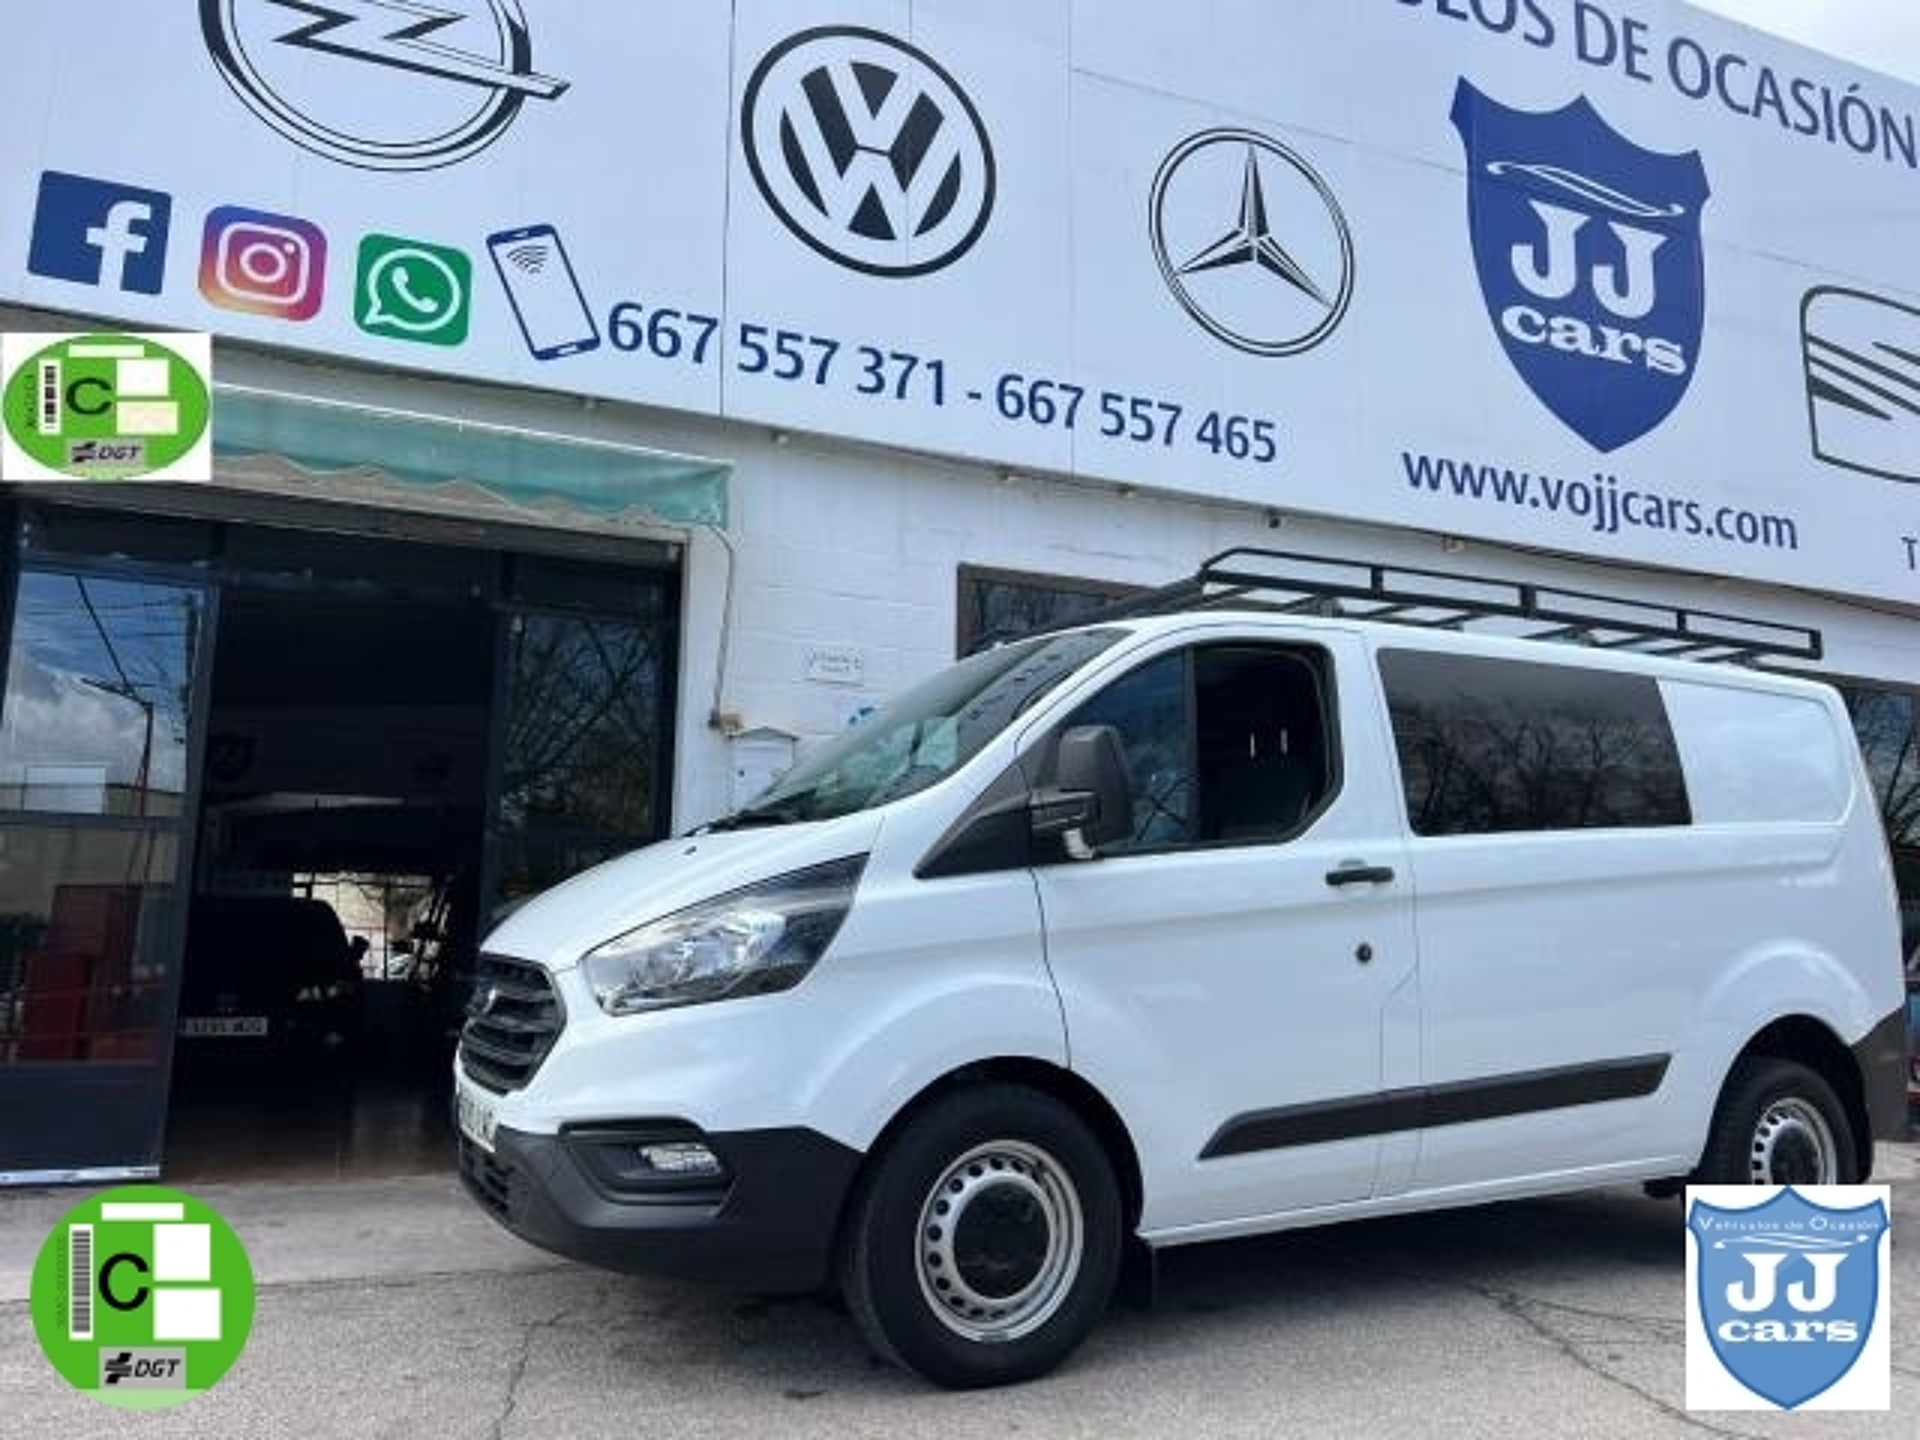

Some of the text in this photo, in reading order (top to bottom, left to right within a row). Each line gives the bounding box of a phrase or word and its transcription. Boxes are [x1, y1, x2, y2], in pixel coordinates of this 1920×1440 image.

[1573, 0, 1653, 83] DE
[1668, 37, 1918, 169] OCASIÓN
[1510, 200, 1669, 319] JJ
[608, 302, 718, 364] 667
[737, 323, 840, 385] 557
[856, 346, 944, 406] 371
[997, 374, 1084, 429] 667
[1101, 392, 1183, 446] 557
[1196, 411, 1277, 462] 465
[1501, 304, 1686, 375] cars
[1402, 451, 1799, 550] www.vojjcars.com
